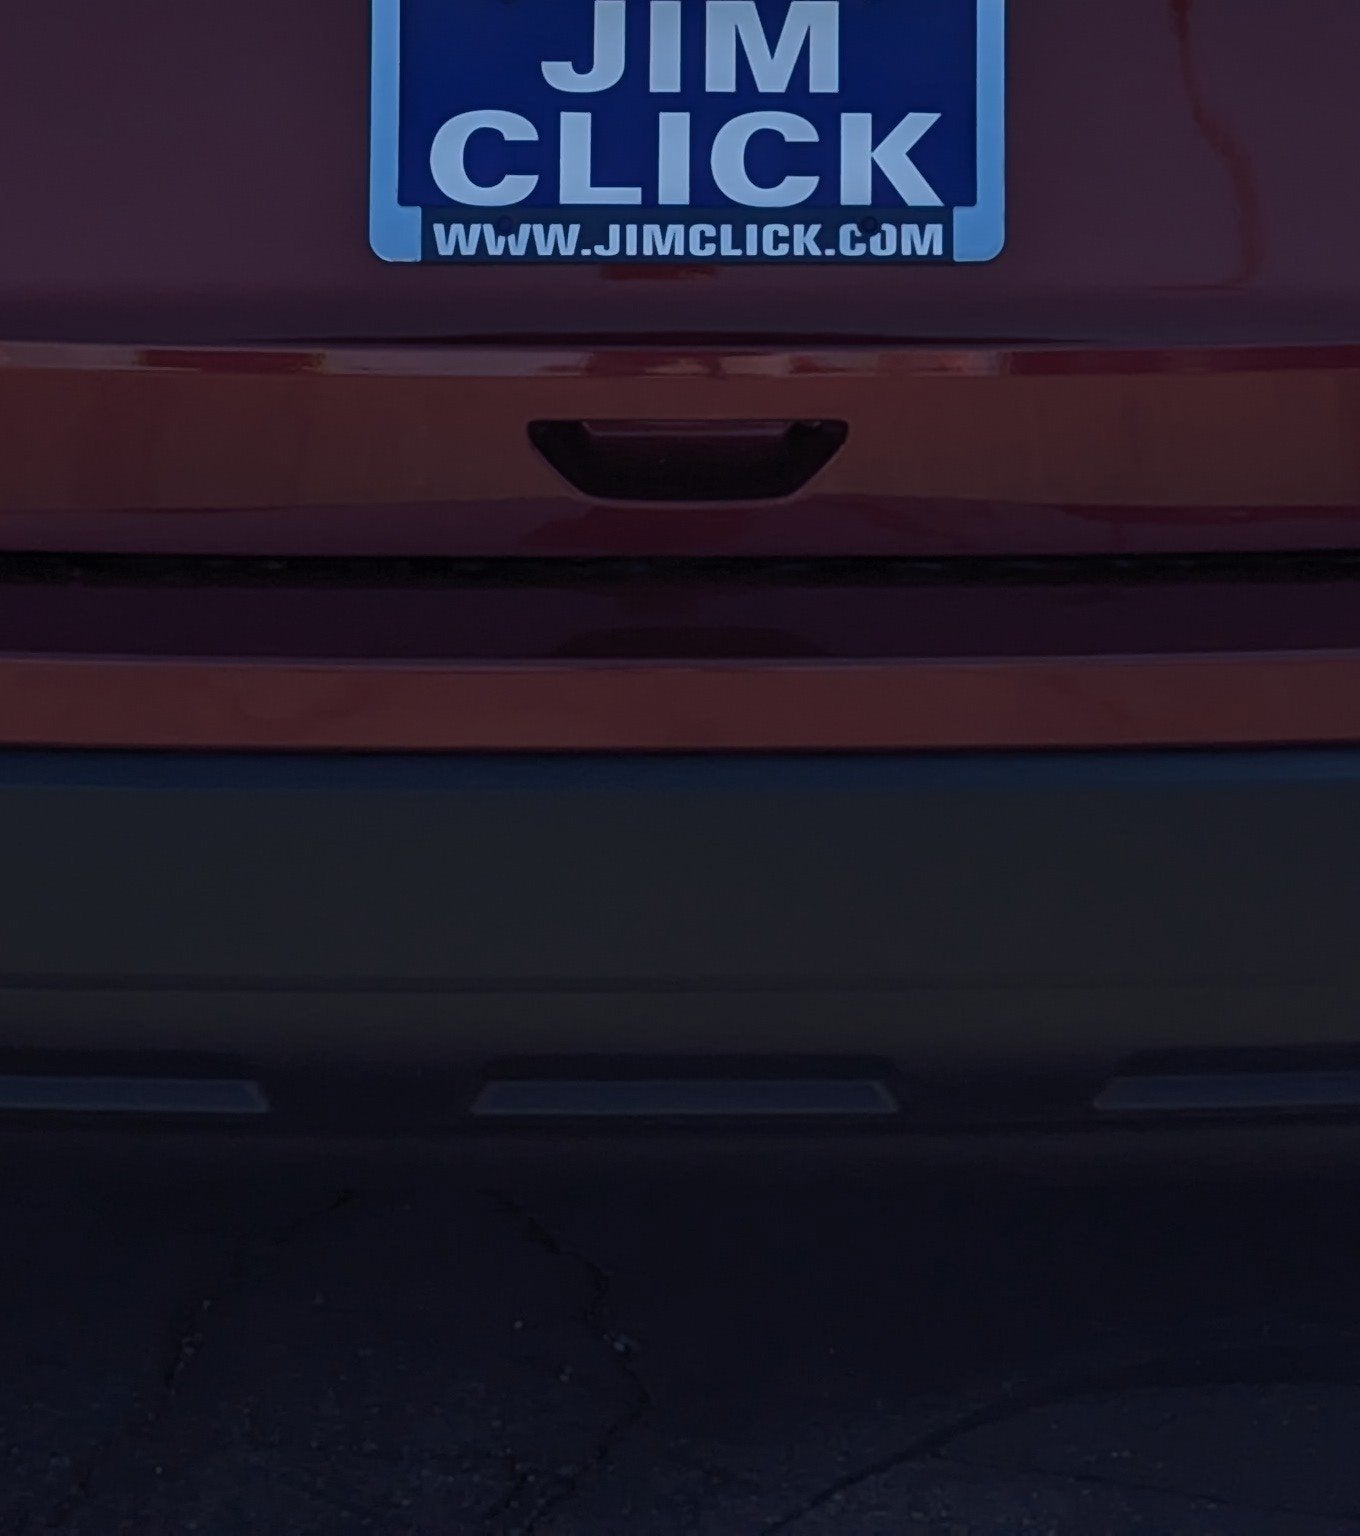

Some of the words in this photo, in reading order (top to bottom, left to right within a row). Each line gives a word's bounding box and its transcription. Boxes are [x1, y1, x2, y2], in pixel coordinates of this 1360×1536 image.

[540, 0, 840, 95] JIM
[428, 109, 945, 208] CLICK
[432, 222, 944, 257] WWW.JIMCLICK.COM
